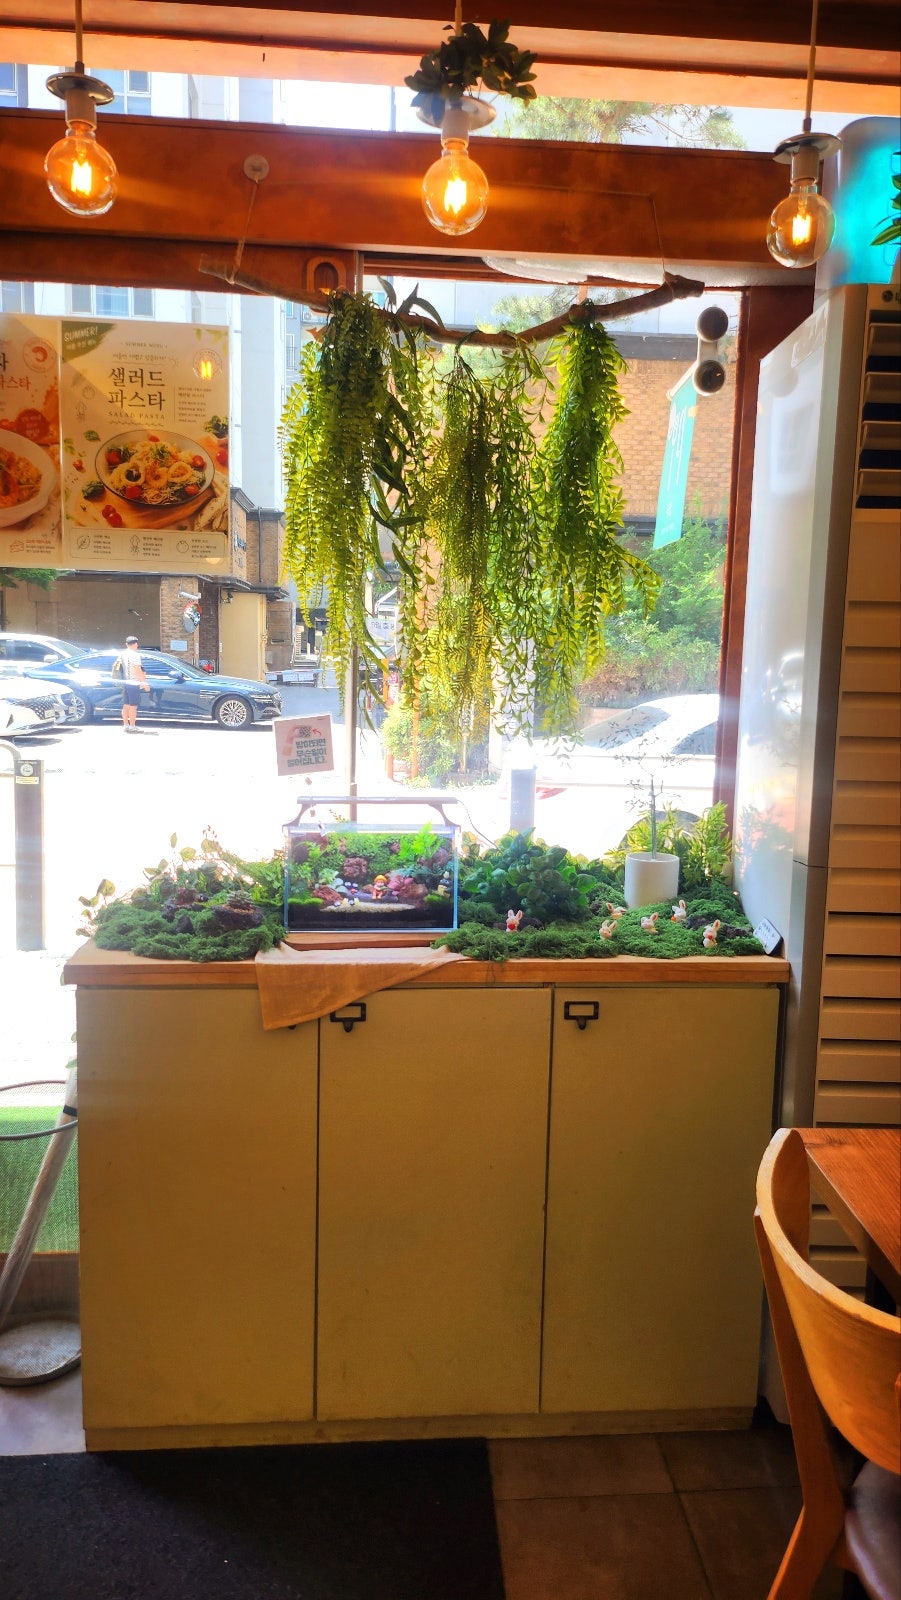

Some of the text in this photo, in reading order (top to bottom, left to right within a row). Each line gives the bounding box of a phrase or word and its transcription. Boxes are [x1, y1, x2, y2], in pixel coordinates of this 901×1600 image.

[64, 325, 98, 342] SUMMER!
[108, 366, 165, 388] 샐러드
[108, 389, 166, 411] 파스타
[108, 411, 165, 420] SALAD PASTA
